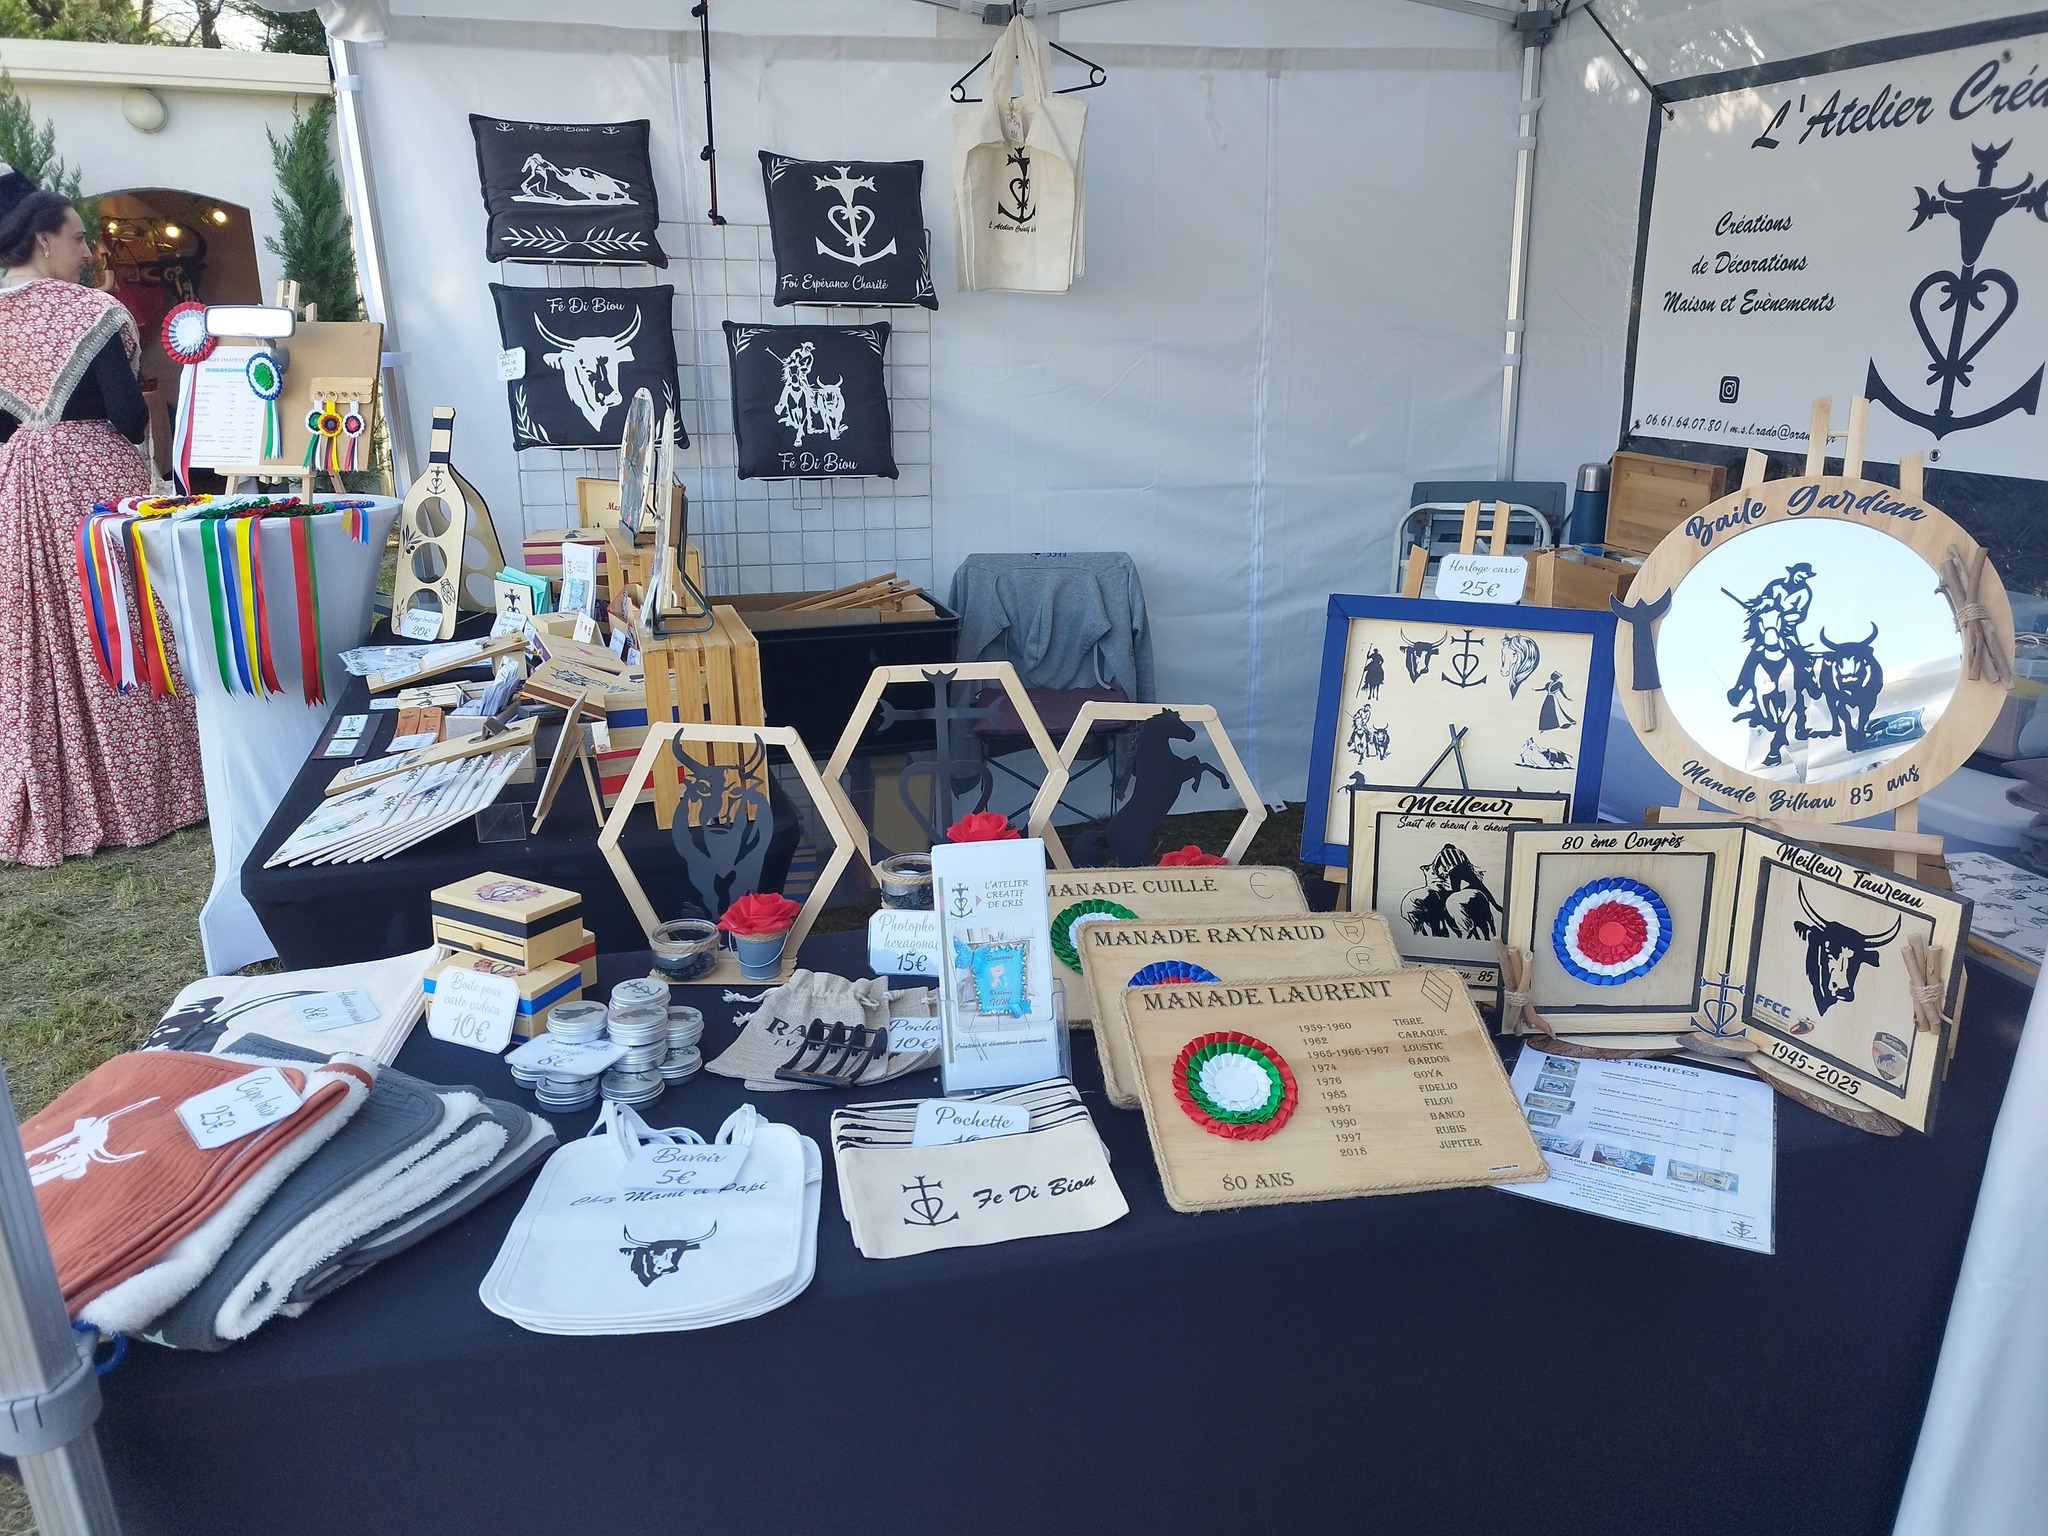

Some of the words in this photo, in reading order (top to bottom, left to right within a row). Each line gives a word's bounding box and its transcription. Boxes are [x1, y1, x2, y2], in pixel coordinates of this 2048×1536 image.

[1751, 83, 1935, 150] L'Atelier
[1714, 210, 1793, 237] Créations
[1691, 254, 1709, 275] de
[1714, 251, 1808, 275] Décorations
[781, 274, 799, 293] Foi
[802, 273, 851, 294] Espérance
[852, 272, 888, 291] Charité
[546, 297, 565, 314] Fé
[568, 297, 589, 314] Di
[592, 297, 626, 314] Biou
[1663, 290, 1716, 313] Maison
[1720, 294, 1738, 312] et
[1740, 288, 1836, 315] Evènements
[1645, 413, 1722, 432] 06.61.64.07.80
[778, 452, 797, 471] Fé
[800, 452, 821, 472] Di
[823, 452, 859, 472] Biou
[1685, 497, 1767, 547] Baile
[1788, 483, 1928, 523] Gardian
[1449, 557, 1490, 577] Horloge
[1492, 562, 1522, 576] carré
[1460, 578, 1500, 598] 25€
[411, 625, 432, 637] 20€
[1681, 758, 1757, 805] Manade
[1850, 786, 1874, 806] 85
[1886, 763, 1920, 793] ans
[1397, 794, 1514, 816] Meilleur
[1397, 815, 1424, 829] Saut
[1425, 820, 1437, 829] de
[1440, 818, 1470, 832] cheval
[1471, 820, 1480, 831] à
[1483, 821, 1509, 833] cheva
[1561, 835, 1585, 850] 80
[1590, 833, 1618, 849] ème
[1623, 831, 1686, 851] Congrès
[984, 879, 1029, 890] L'ATELIER
[1776, 842, 1844, 884] Meilleur
[1852, 869, 1925, 909] Taureau
[986, 889, 1026, 899] CREATIF
[1048, 879, 1139, 898] MANADE
[1142, 876, 1219, 894] CUILLÉ
[987, 899, 1002, 909] DE
[1003, 898, 1024, 908] CRIS
[1094, 929, 1201, 948] MANADE
[1207, 924, 1326, 944] RAYNAUD
[897, 951, 927, 973] 15€
[1477, 970, 1496, 982] 85
[481, 984, 503, 1000] pour
[1142, 987, 1264, 1011] MANADE
[1270, 979, 1393, 1006] LAURENT
[444, 994, 468, 1009] carte
[468, 999, 502, 1016] cadeau
[1755, 993, 1792, 1019] FFCC
[452, 1012, 490, 1043] 10€
[1298, 1021, 1352, 1033] 1959-1960
[1392, 1016, 1424, 1027] TIGRE
[1302, 1036, 1329, 1046] 1962
[1398, 1027, 1447, 1040] CARAQUE
[894, 1036, 936, 1050] 10€
[1403, 1041, 1445, 1053] LOUSTIC
[1307, 1046, 1390, 1060] 1965-1966-1967
[1408, 1055, 1451, 1066] GARDON
[1311, 1063, 1338, 1073] 1974
[1413, 1069, 1444, 1080] GOYA
[1625, 1059, 1700, 1078] TROPHÉES
[1771, 1041, 1862, 1096] 1945-2025
[1316, 1076, 1342, 1087] 1976
[1419, 1082, 1459, 1093] FIDELIO
[1321, 1089, 1348, 1100] 1985
[1424, 1096, 1454, 1107] FILOU
[935, 1105, 1015, 1129] Pochette
[1325, 1103, 1352, 1114] 1987
[1429, 1110, 1465, 1121] BANCO
[200, 1105, 236, 1134] 25€
[1330, 1117, 1357, 1129] 1990
[1335, 1132, 1361, 1143] 1997
[1435, 1124, 1467, 1135] RUBIS
[1340, 1146, 1368, 1157] 2018
[1439, 1138, 1482, 1150] JUPITER
[652, 1147, 728, 1165] Bavoir
[656, 1169, 697, 1185] 5€
[1222, 1173, 1248, 1192] 80
[1254, 1171, 1296, 1190] ANS
[570, 1194, 617, 1207] Chez
[624, 1187, 686, 1203] Mami
[973, 1188, 1004, 1210] Fe
[1009, 1184, 1040, 1203] Di
[1047, 1174, 1097, 1197] Biou
